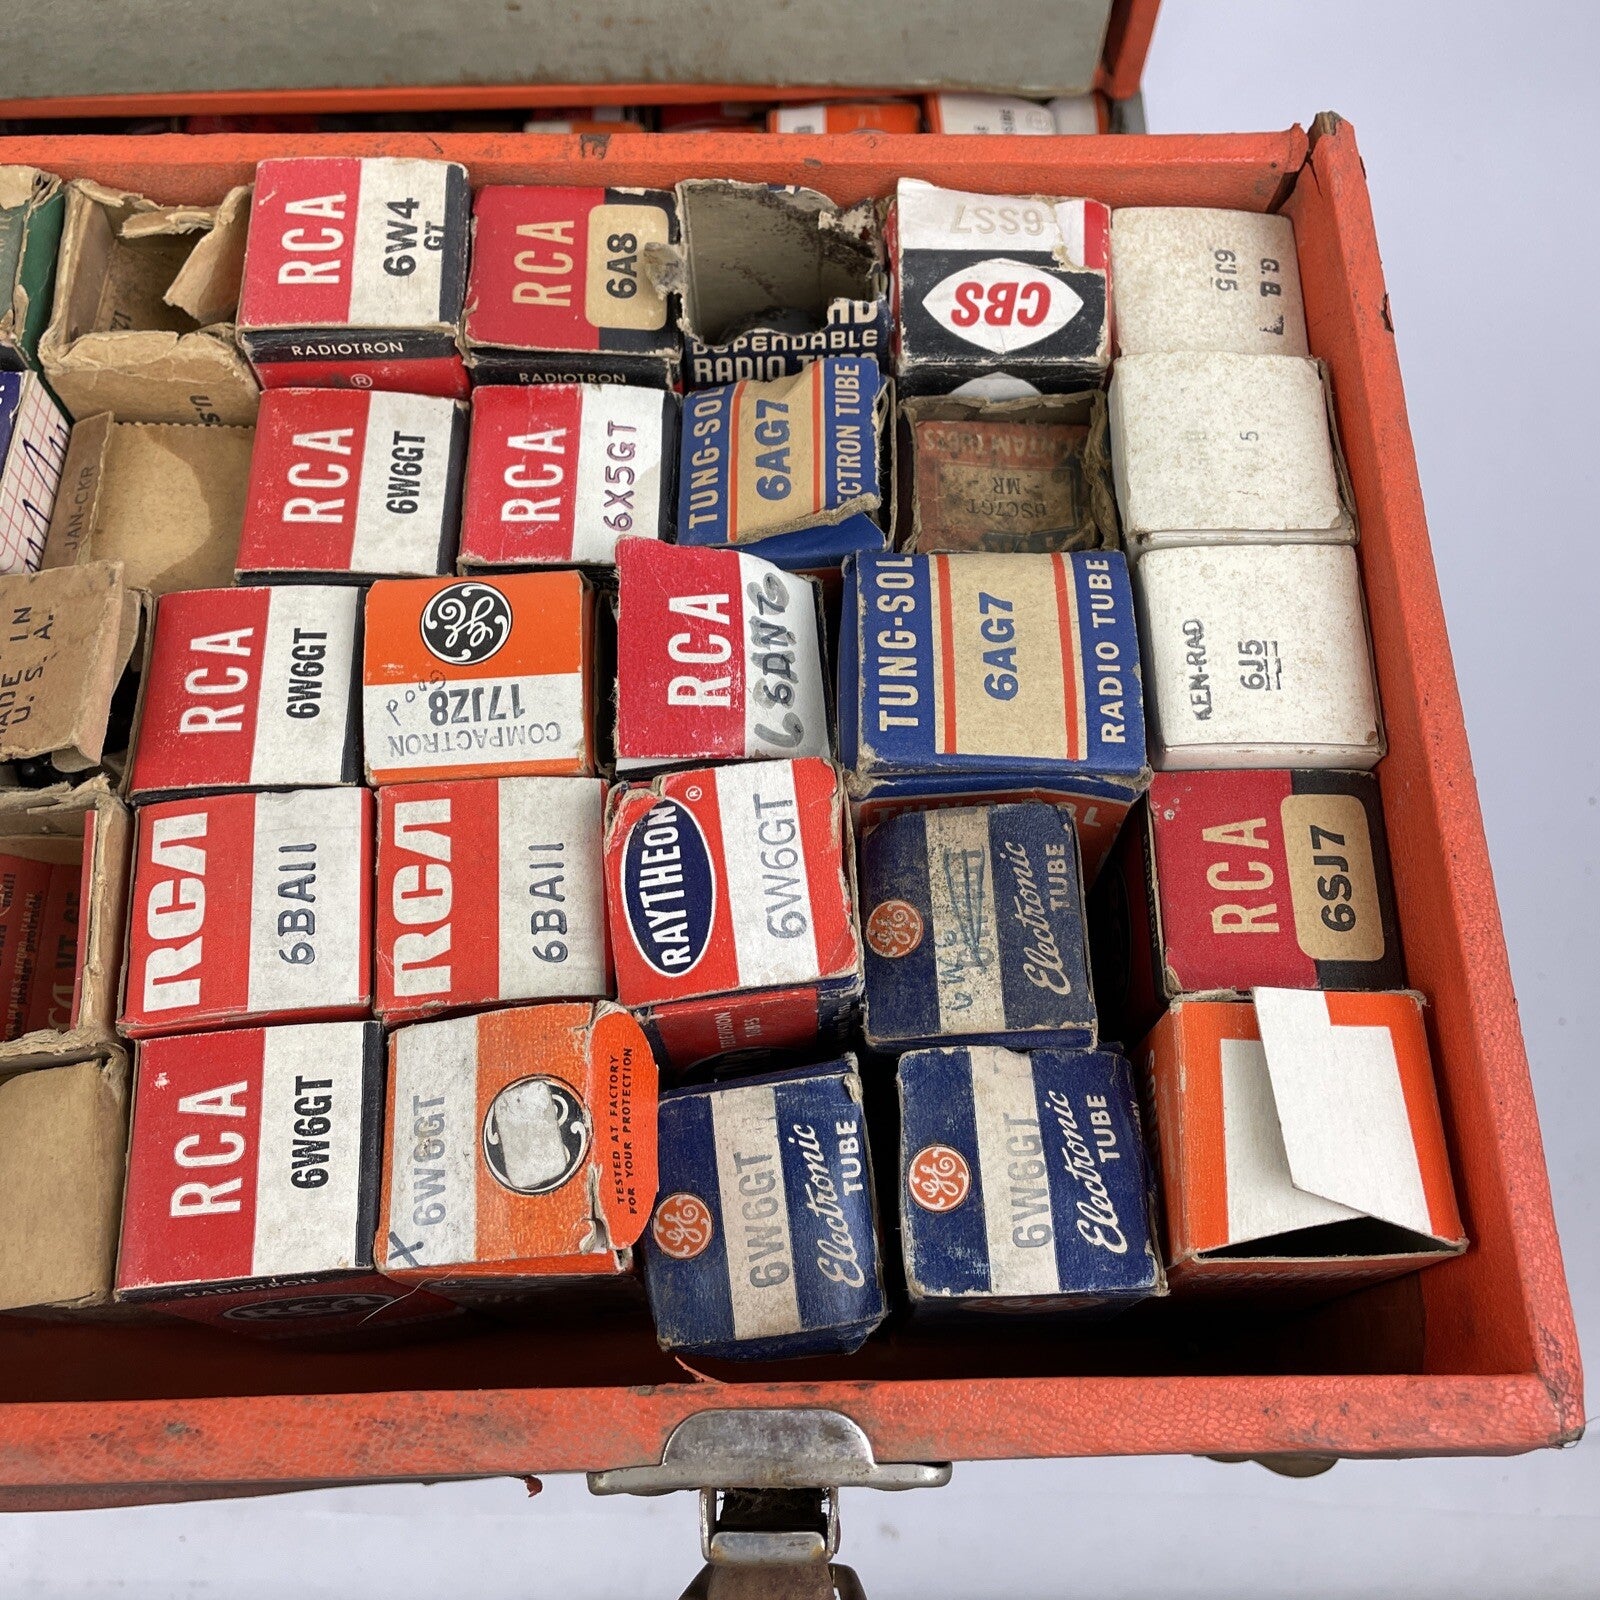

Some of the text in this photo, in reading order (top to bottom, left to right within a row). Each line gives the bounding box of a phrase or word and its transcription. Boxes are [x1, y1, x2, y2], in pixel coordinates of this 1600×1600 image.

[277, 194, 347, 285] RCA
[383, 197, 420, 277] 6W4
[423, 222, 446, 251] GT
[512, 220, 575, 308] RCA
[606, 232, 639, 299] 6A8
[952, 204, 1045, 237] 6SS7
[290, 342, 404, 357] RADIOTRON
[949, 281, 1052, 327] CBS
[518, 371, 627, 385] RADIOTRON
[693, 355, 787, 383] RADIO
[835, 363, 861, 418] TUBE
[282, 428, 354, 524] RCA
[386, 431, 426, 515] 6W6GT
[500, 427, 569, 522] RCA
[603, 420, 637, 532] 6X5GT
[687, 386, 723, 530] TUNG-SOL
[755, 400, 790, 501] 6AG7
[992, 477, 1021, 495] MR
[65, 465, 96, 550] JAN-CKR
[10, 607, 32, 642] IN
[286, 627, 328, 720] 6W6GT
[667, 593, 731, 708] RCA
[876, 556, 919, 733] TUNG-SOL
[978, 591, 1020, 702] 6AG7
[1091, 558, 1127, 745] RADIO TUBE
[1182, 618, 1212, 721] KEN-RAD
[1237, 640, 1265, 690] 6J5
[180, 627, 254, 735] RCA
[427, 683, 526, 726] 17JZ8
[387, 721, 562, 758] COMPACTRON
[143, 812, 208, 1013] RCA
[278, 842, 318, 965] 6BA11
[392, 798, 453, 997] RCA
[528, 842, 569, 964] 6BA11
[639, 805, 692, 969] RAYTHEON
[752, 793, 808, 940] 6W6GT
[1048, 843, 1070, 914] TUBE
[1201, 817, 1280, 935] RCA
[1309, 824, 1357, 932] 6SJ7
[1019, 841, 1072, 996] Electronic
[718, 1011, 735, 1049] TELEVISION
[170, 1079, 249, 1220] RCA
[290, 1074, 334, 1190] 6W6GT
[412, 1094, 446, 1228] 6W6GT
[608, 1054, 626, 1205] TESTED AT FACTORY
[621, 1047, 637, 1214] FOR YOUR PROTECTION
[835, 1119, 864, 1198] TUBE
[1074, 1089, 1128, 1255] Electronic
[1096, 1094, 1123, 1165] TUBE
[733, 1150, 792, 1291] 6W6GT
[786, 1123, 867, 1289] Electronic
[1001, 1111, 1053, 1251] 6W6GT
[185, 1276, 320, 1298] RADIOTRON
